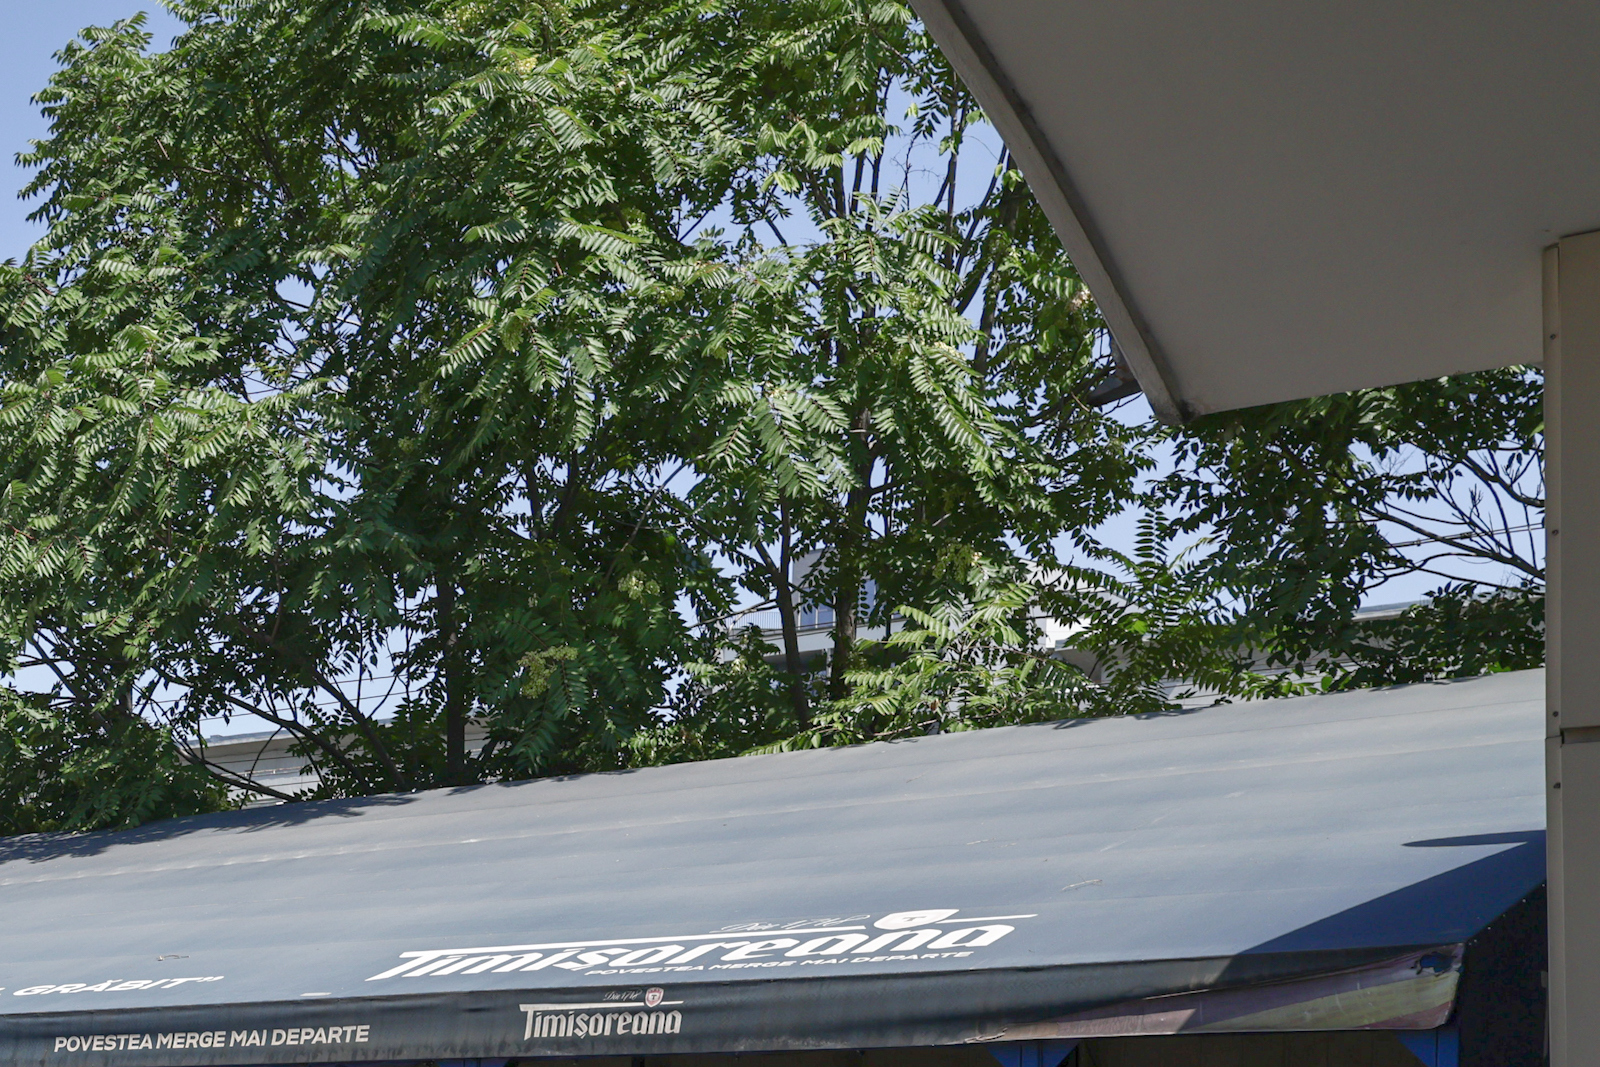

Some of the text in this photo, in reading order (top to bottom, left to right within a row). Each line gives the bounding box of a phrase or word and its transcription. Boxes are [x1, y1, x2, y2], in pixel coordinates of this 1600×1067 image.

[365, 914, 1038, 981] Timișoreana
[584, 951, 975, 975] POVESTEA MERGE MAI DEPARTE
[519, 1001, 684, 1041] Timișoreana
[54, 1025, 370, 1052] POVESTEA MERGE MAI DEPARTE
